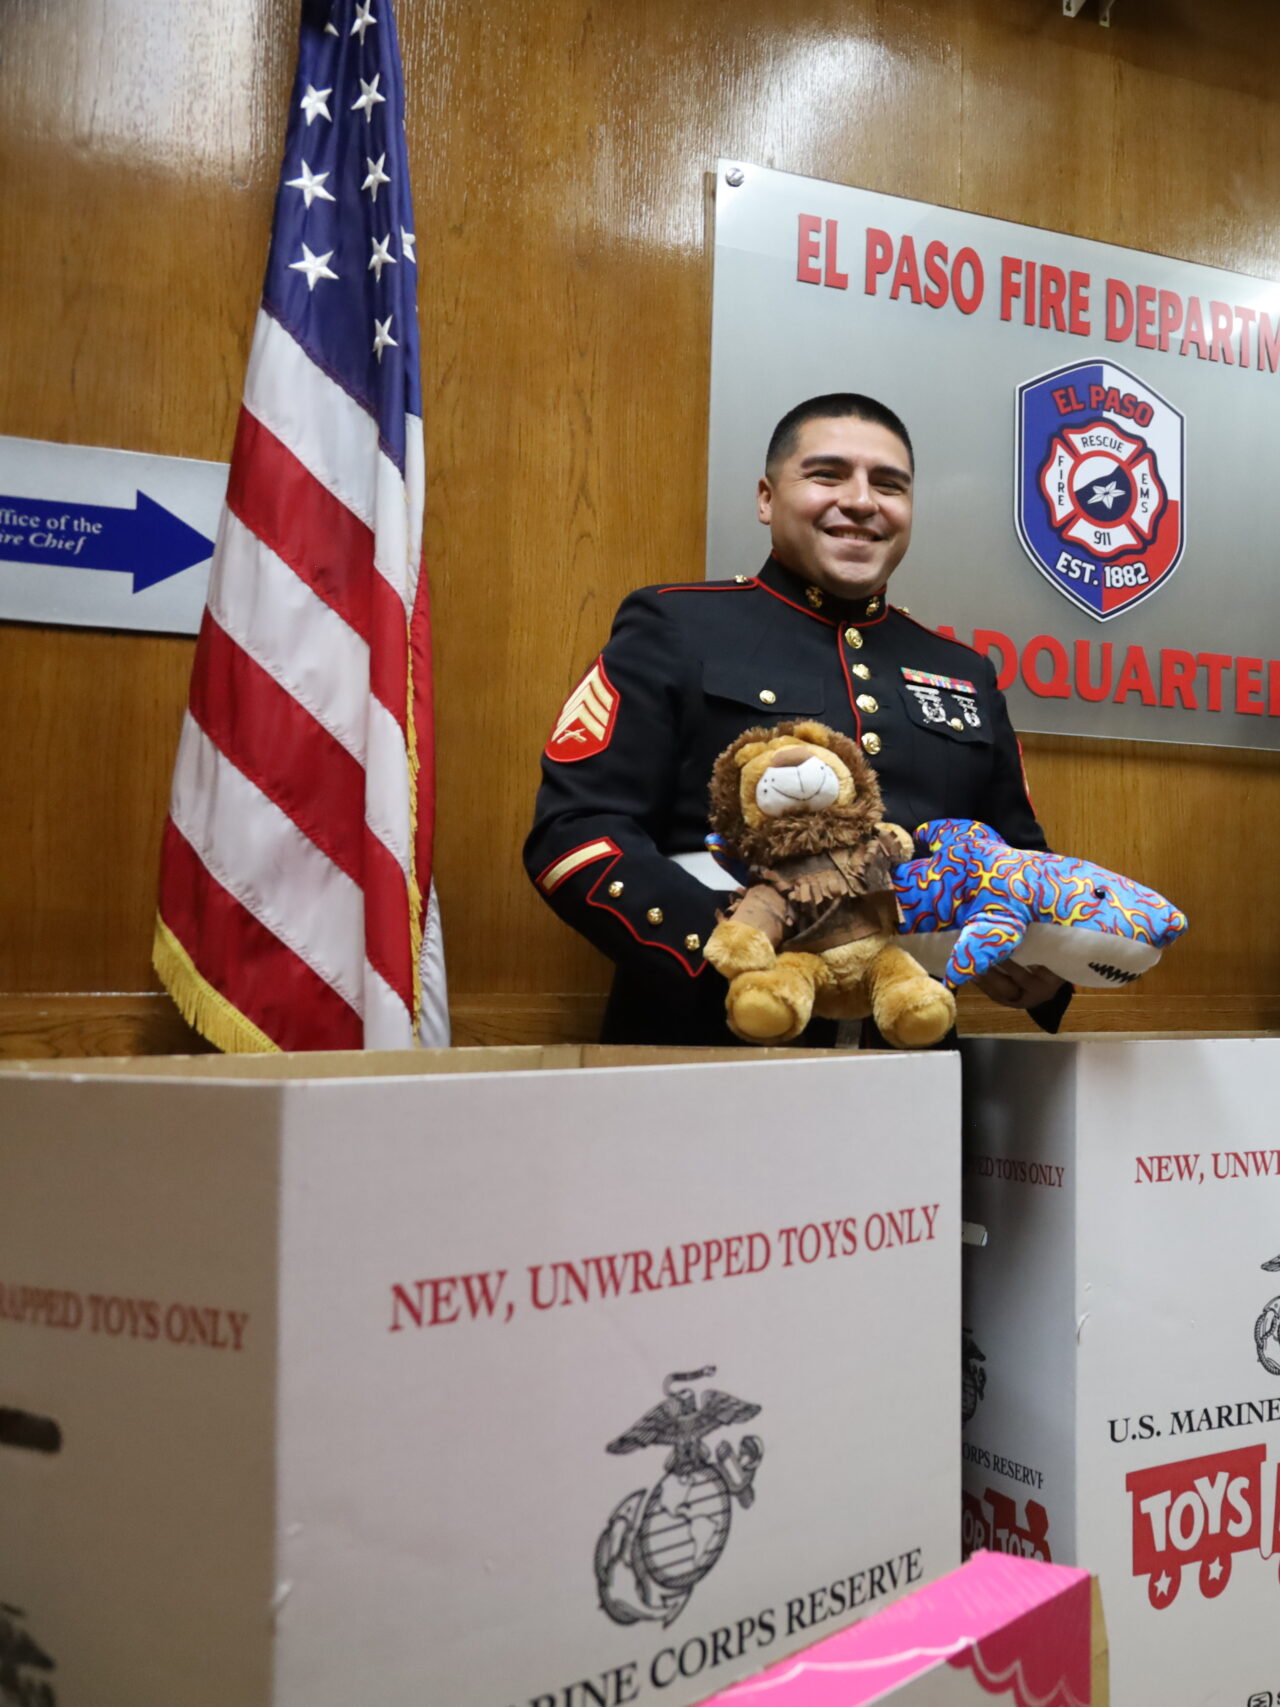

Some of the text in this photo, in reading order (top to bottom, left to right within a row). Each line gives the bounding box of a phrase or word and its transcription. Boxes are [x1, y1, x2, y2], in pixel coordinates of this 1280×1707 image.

[796, 213, 848, 290] EL
[864, 227, 985, 315] PASO
[999, 255, 1091, 337] FIRE
[1052, 385, 1155, 428] EL PASO
[1081, 436, 1124, 453] RESCUE
[1057, 455, 1066, 506] FIRE
[1140, 473, 1149, 513] EMS
[0, 508, 103, 534] ffice of the
[1093, 531, 1112, 546] 911
[0, 529, 87, 555] ire Chief
[1056, 551, 1150, 588] EST. 1882
[996, 1158, 1027, 1182] TOYS
[1029, 1163, 1064, 1188] ONLY
[1134, 1153, 1205, 1185] NEW,
[388, 1203, 940, 1332] NEW, UNWRAPPED TOYS ONLY
[89, 1293, 160, 1341] TOYS
[165, 1304, 249, 1350] ONLY
[1107, 1414, 1162, 1443] U.S.
[962, 1442, 990, 1469] ORPS
[962, 1509, 985, 1552] OR
[1140, 1471, 1253, 1552] TOYS
[649, 1609, 776, 1690] CORPS
[785, 1547, 925, 1637] RESERVE
